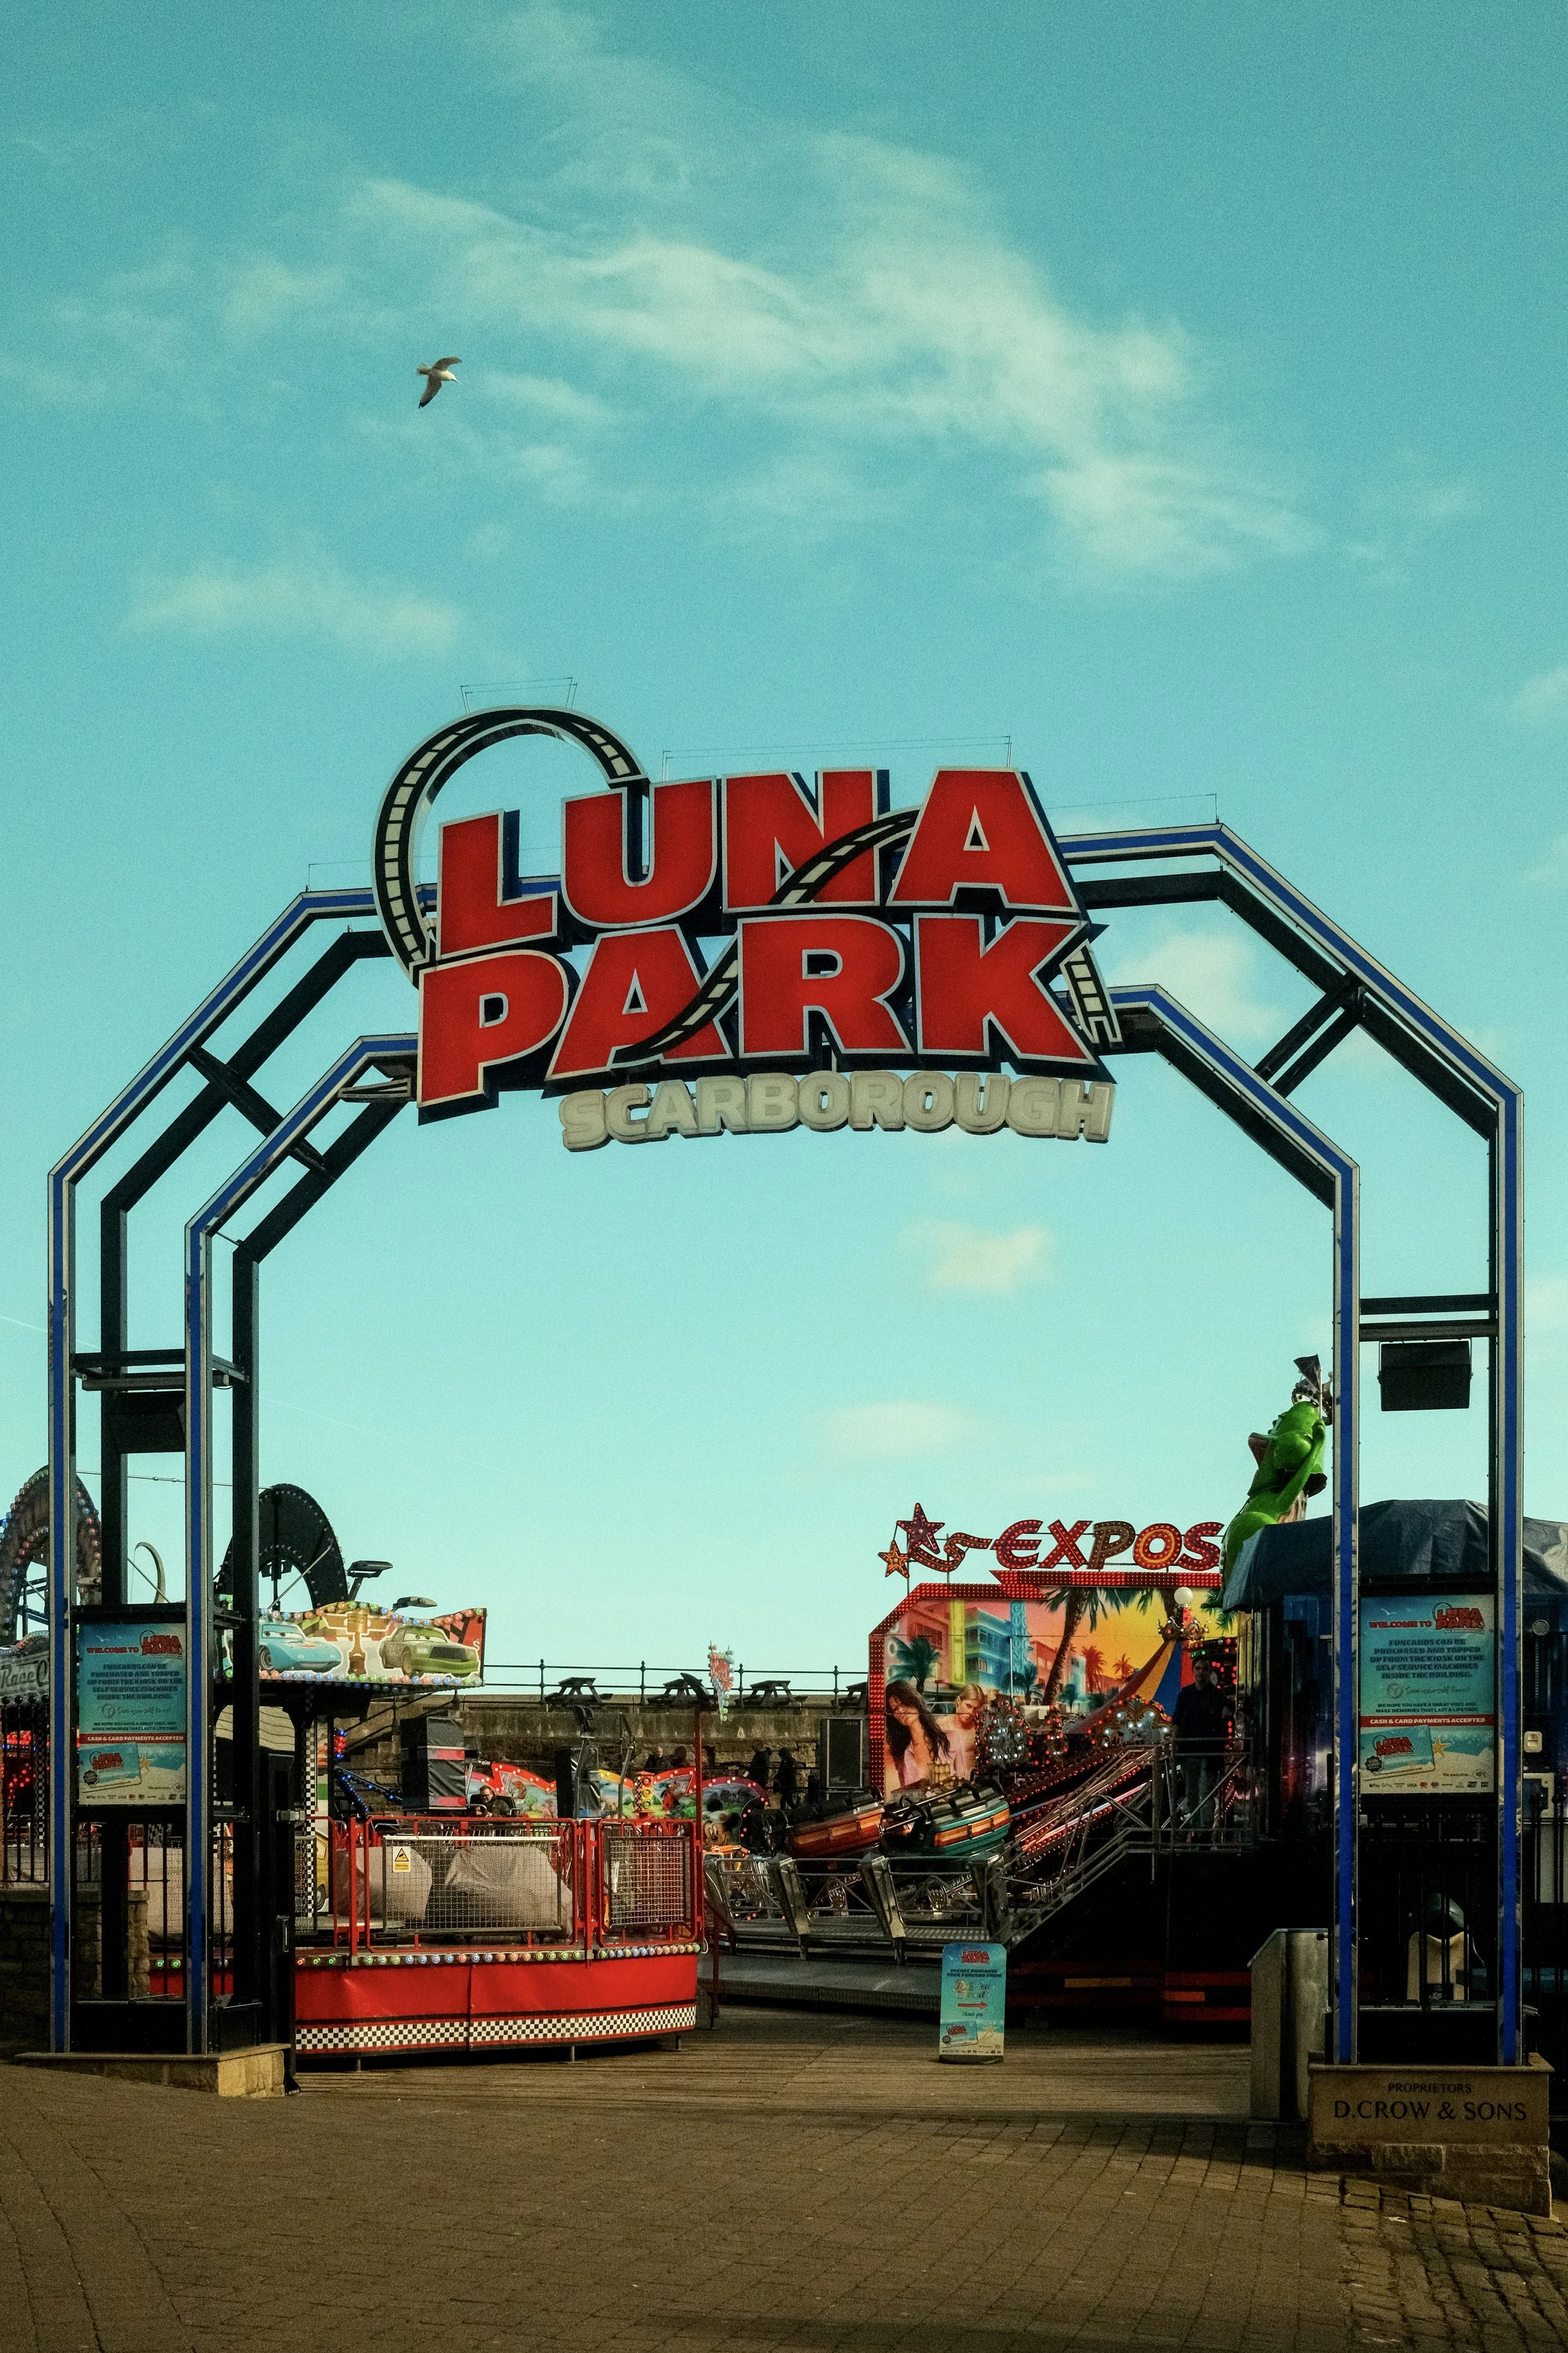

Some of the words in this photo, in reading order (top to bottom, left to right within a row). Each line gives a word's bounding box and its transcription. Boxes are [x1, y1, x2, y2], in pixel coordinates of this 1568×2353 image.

[439, 766, 1081, 960] LUNA
[416, 913, 1101, 1109] PARK
[558, 1070, 1116, 1152] SCARBOROUGH
[1437, 1607, 1483, 1620] LUNA
[1436, 1617, 1484, 1630] PARK
[143, 1635, 181, 1646] LUNA
[142, 1644, 183, 1656] PARK
[1388, 2083, 1473, 2094] PROPRIETORS
[1334, 2100, 1430, 2120] D.CROW
[1438, 2101, 1456, 2120] &
[1464, 2101, 1527, 2121] SONS
